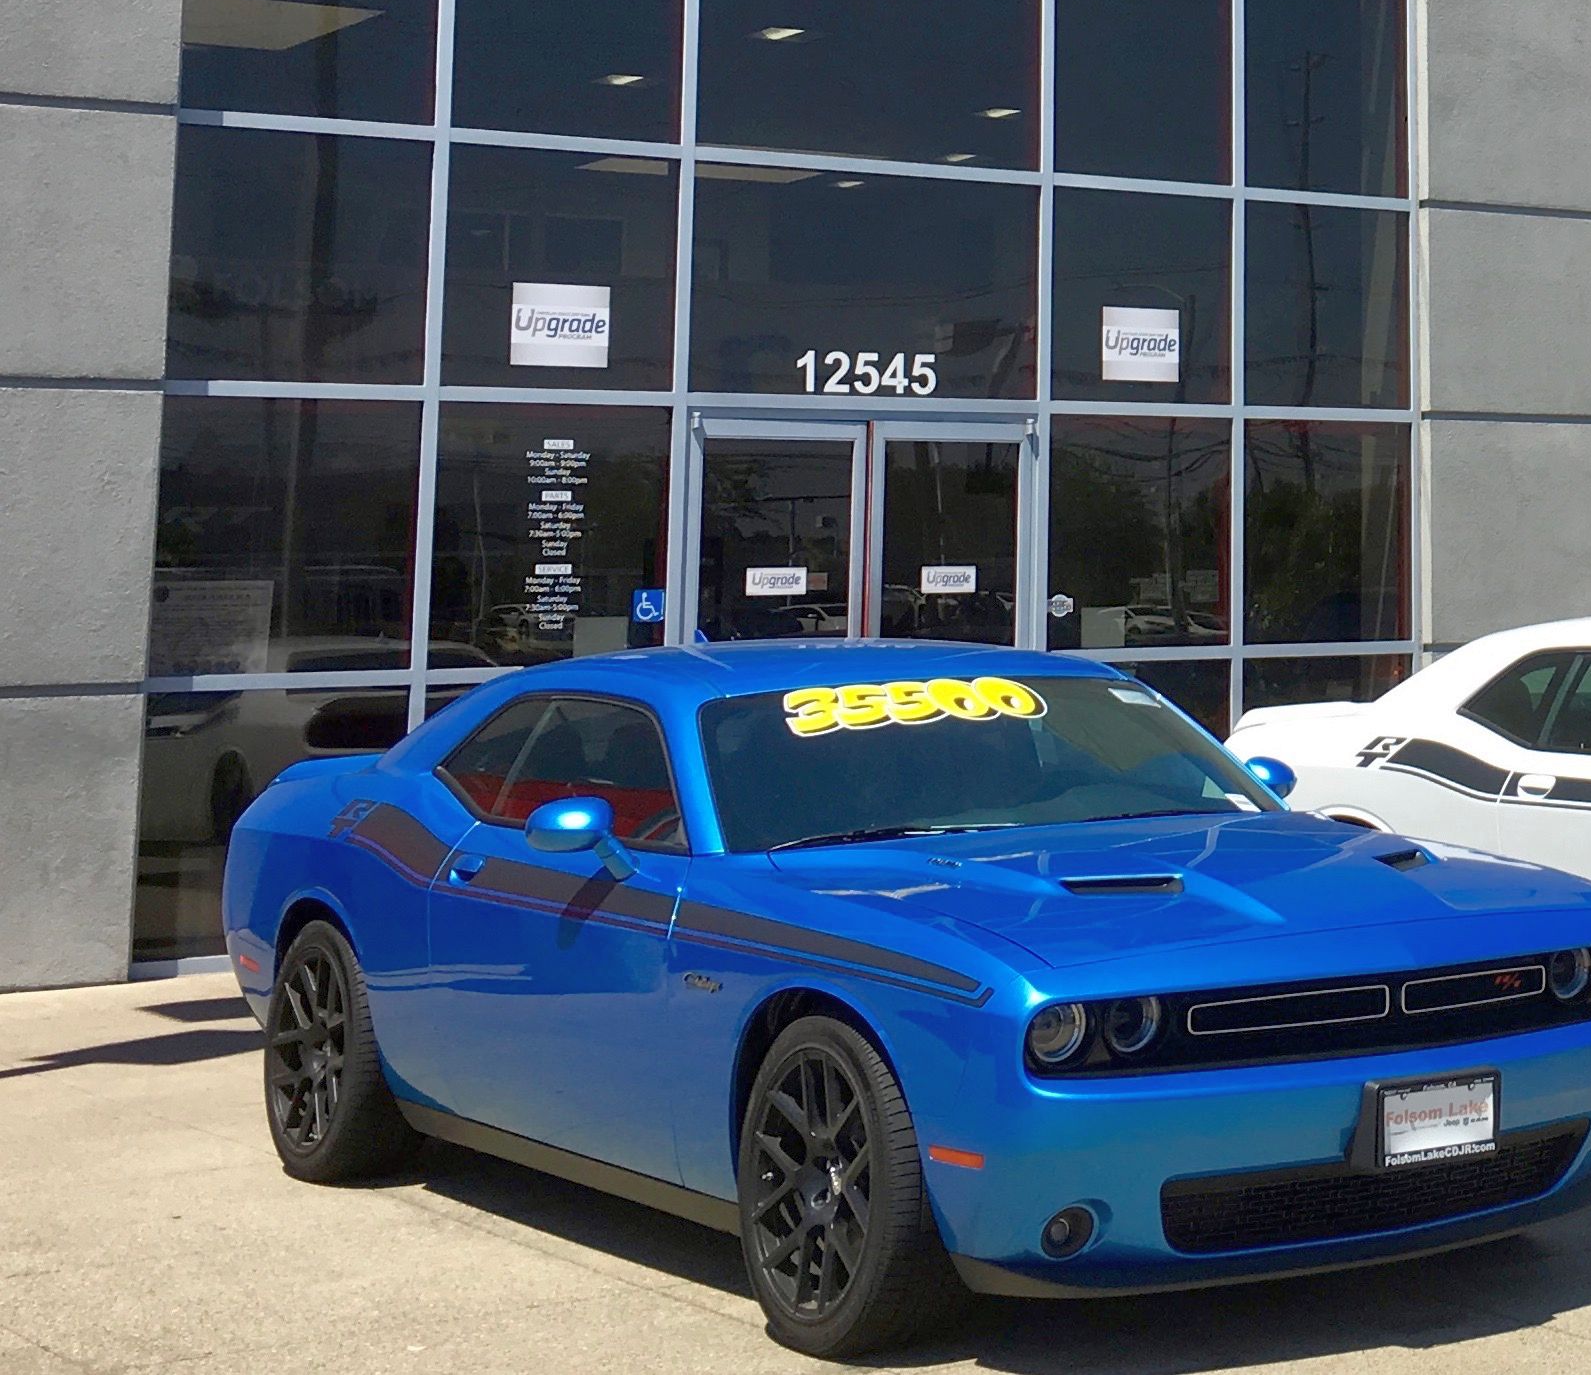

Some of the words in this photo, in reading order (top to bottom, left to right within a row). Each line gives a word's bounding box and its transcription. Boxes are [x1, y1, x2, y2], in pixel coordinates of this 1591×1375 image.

[515, 307, 606, 338] Upgrade
[1104, 328, 1177, 356] Upgrade
[796, 350, 937, 395] 12545
[526, 451, 555, 460] Monday
[560, 451, 591, 460] Saturday
[545, 468, 571, 476] Sunday
[528, 503, 558, 511] Monday
[540, 521, 571, 529] Saturday
[541, 539, 568, 548] Sunday
[542, 548, 566, 556] Closed
[525, 576, 555, 585] Monday
[559, 576, 581, 584] Friday
[751, 572, 801, 588] Upgrade
[926, 570, 972, 587] Upgrade
[536, 595, 568, 603] Saturday
[539, 613, 565, 621] Sunday
[539, 622, 563, 630] Closed
[784, 677, 1047, 737] 35500
[1386, 1106, 1442, 1126] Folsom
[1448, 1098, 1488, 1117] Lake
